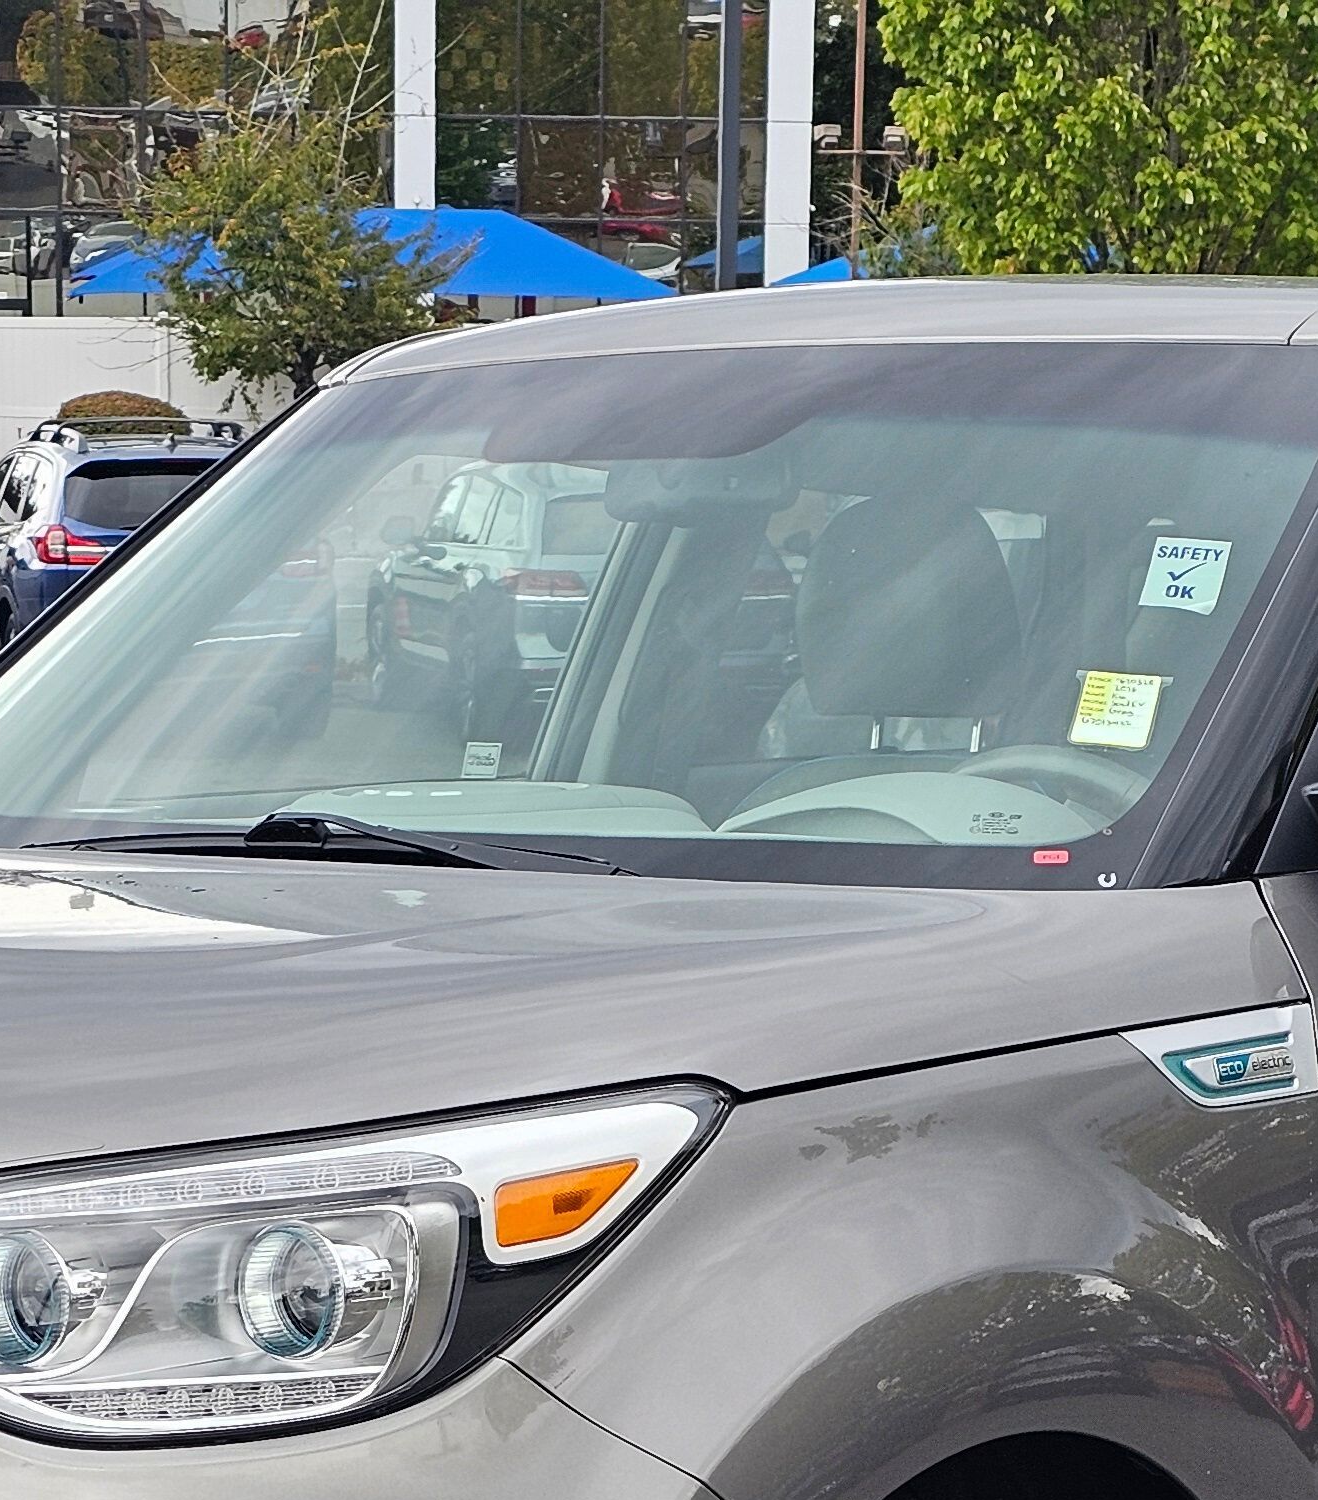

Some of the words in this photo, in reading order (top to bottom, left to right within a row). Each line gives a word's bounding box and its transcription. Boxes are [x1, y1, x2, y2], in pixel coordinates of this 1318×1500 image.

[1157, 545, 1224, 562] SAFETY
[1165, 584, 1195, 600] OK
[1219, 1060, 1244, 1077] ECO
